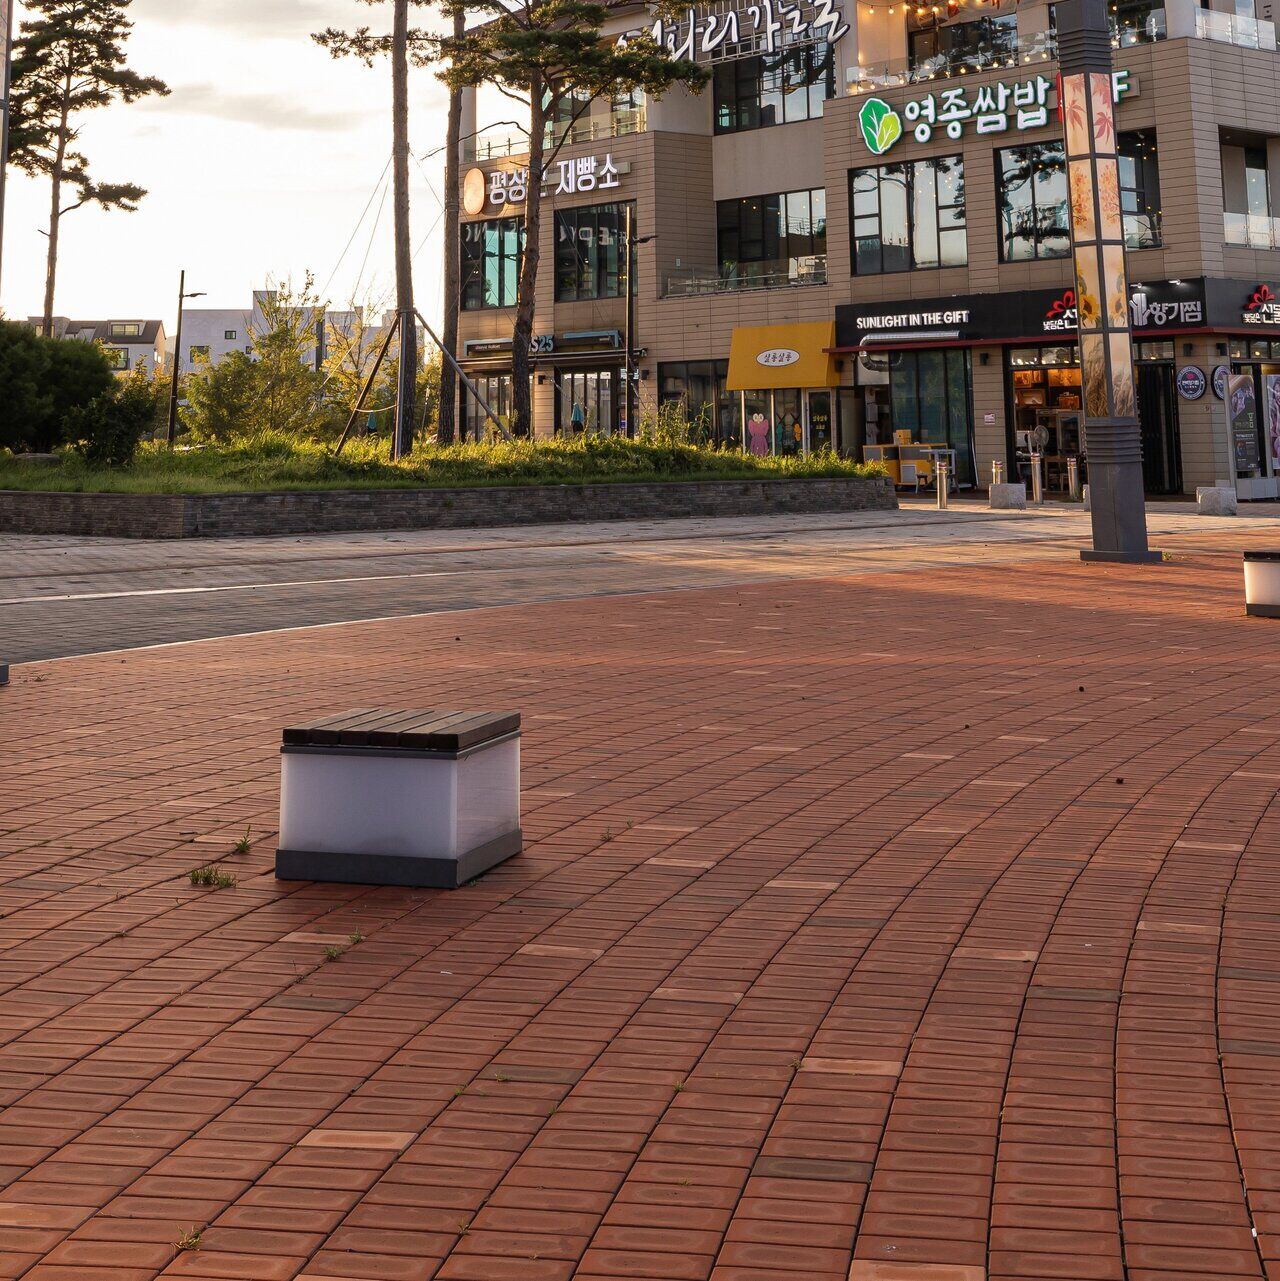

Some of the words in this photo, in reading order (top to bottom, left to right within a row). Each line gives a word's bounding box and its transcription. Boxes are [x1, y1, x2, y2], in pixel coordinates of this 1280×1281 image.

[904, 75, 1051, 143] 영종쌈밥
[1112, 70, 1130, 104] F
[555, 153, 620, 195] 제빵소
[857, 314, 908, 329] SUNLIGHT
[909, 314, 921, 326] IN
[922, 312, 944, 326] THE
[944, 310, 969, 324] GIFT
